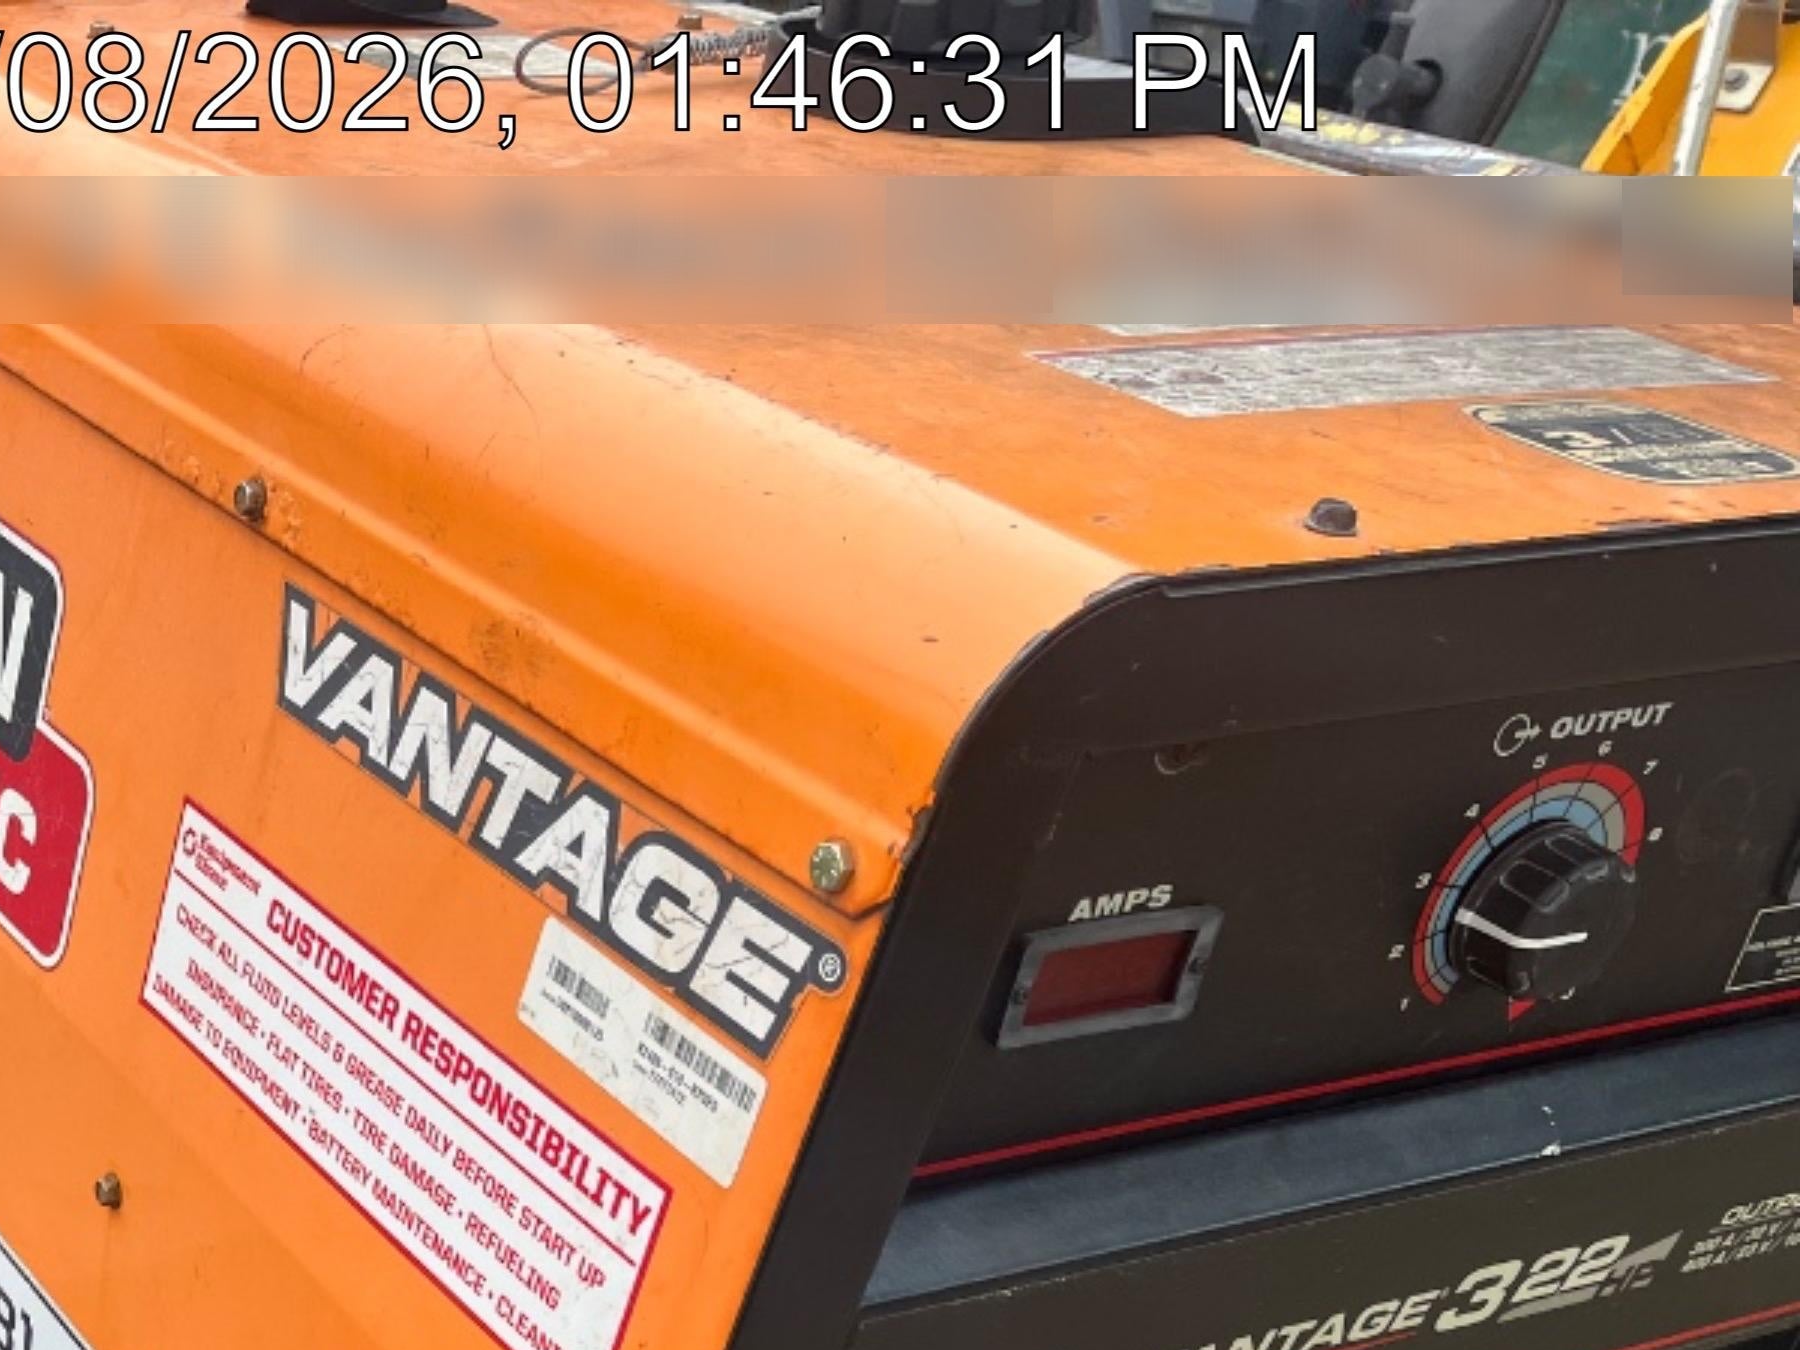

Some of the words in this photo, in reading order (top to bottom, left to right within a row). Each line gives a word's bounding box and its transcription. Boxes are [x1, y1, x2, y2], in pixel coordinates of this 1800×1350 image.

[1550, 702, 1675, 740] OUTPUT
[1643, 758, 1660, 775] 7
[1068, 883, 1174, 923] AMPS
[1414, 872, 1433, 889] 3
[1388, 944, 1406, 960] 2
[176, 903, 218, 952] CHECK
[217, 941, 238, 973] ALL
[281, 996, 332, 1054] LEVELS
[345, 1052, 404, 1117] GREASE
[405, 1105, 454, 1157] DAILY
[453, 1148, 519, 1219] BEFORE
[518, 1205, 577, 1266] START
[577, 1256, 606, 1288] UP
[266, 898, 401, 1033] CUSTOMER
[401, 1009, 652, 1237] RESPONSIBILITY
[206, 1020, 223, 1049] TO
[221, 1038, 301, 1120] EQUIPMENT
[308, 1113, 372, 1186] BATTERY
[371, 1177, 486, 1297] MAINTENANCE
[266, 1031, 301, 1072] FLAT
[302, 1060, 343, 1114] TIRES
[353, 1107, 388, 1155] TIRE
[388, 1142, 457, 1216] DAMAGE
[464, 1211, 561, 1311] REFUELING
[1434, 1234, 1631, 1334] 322
